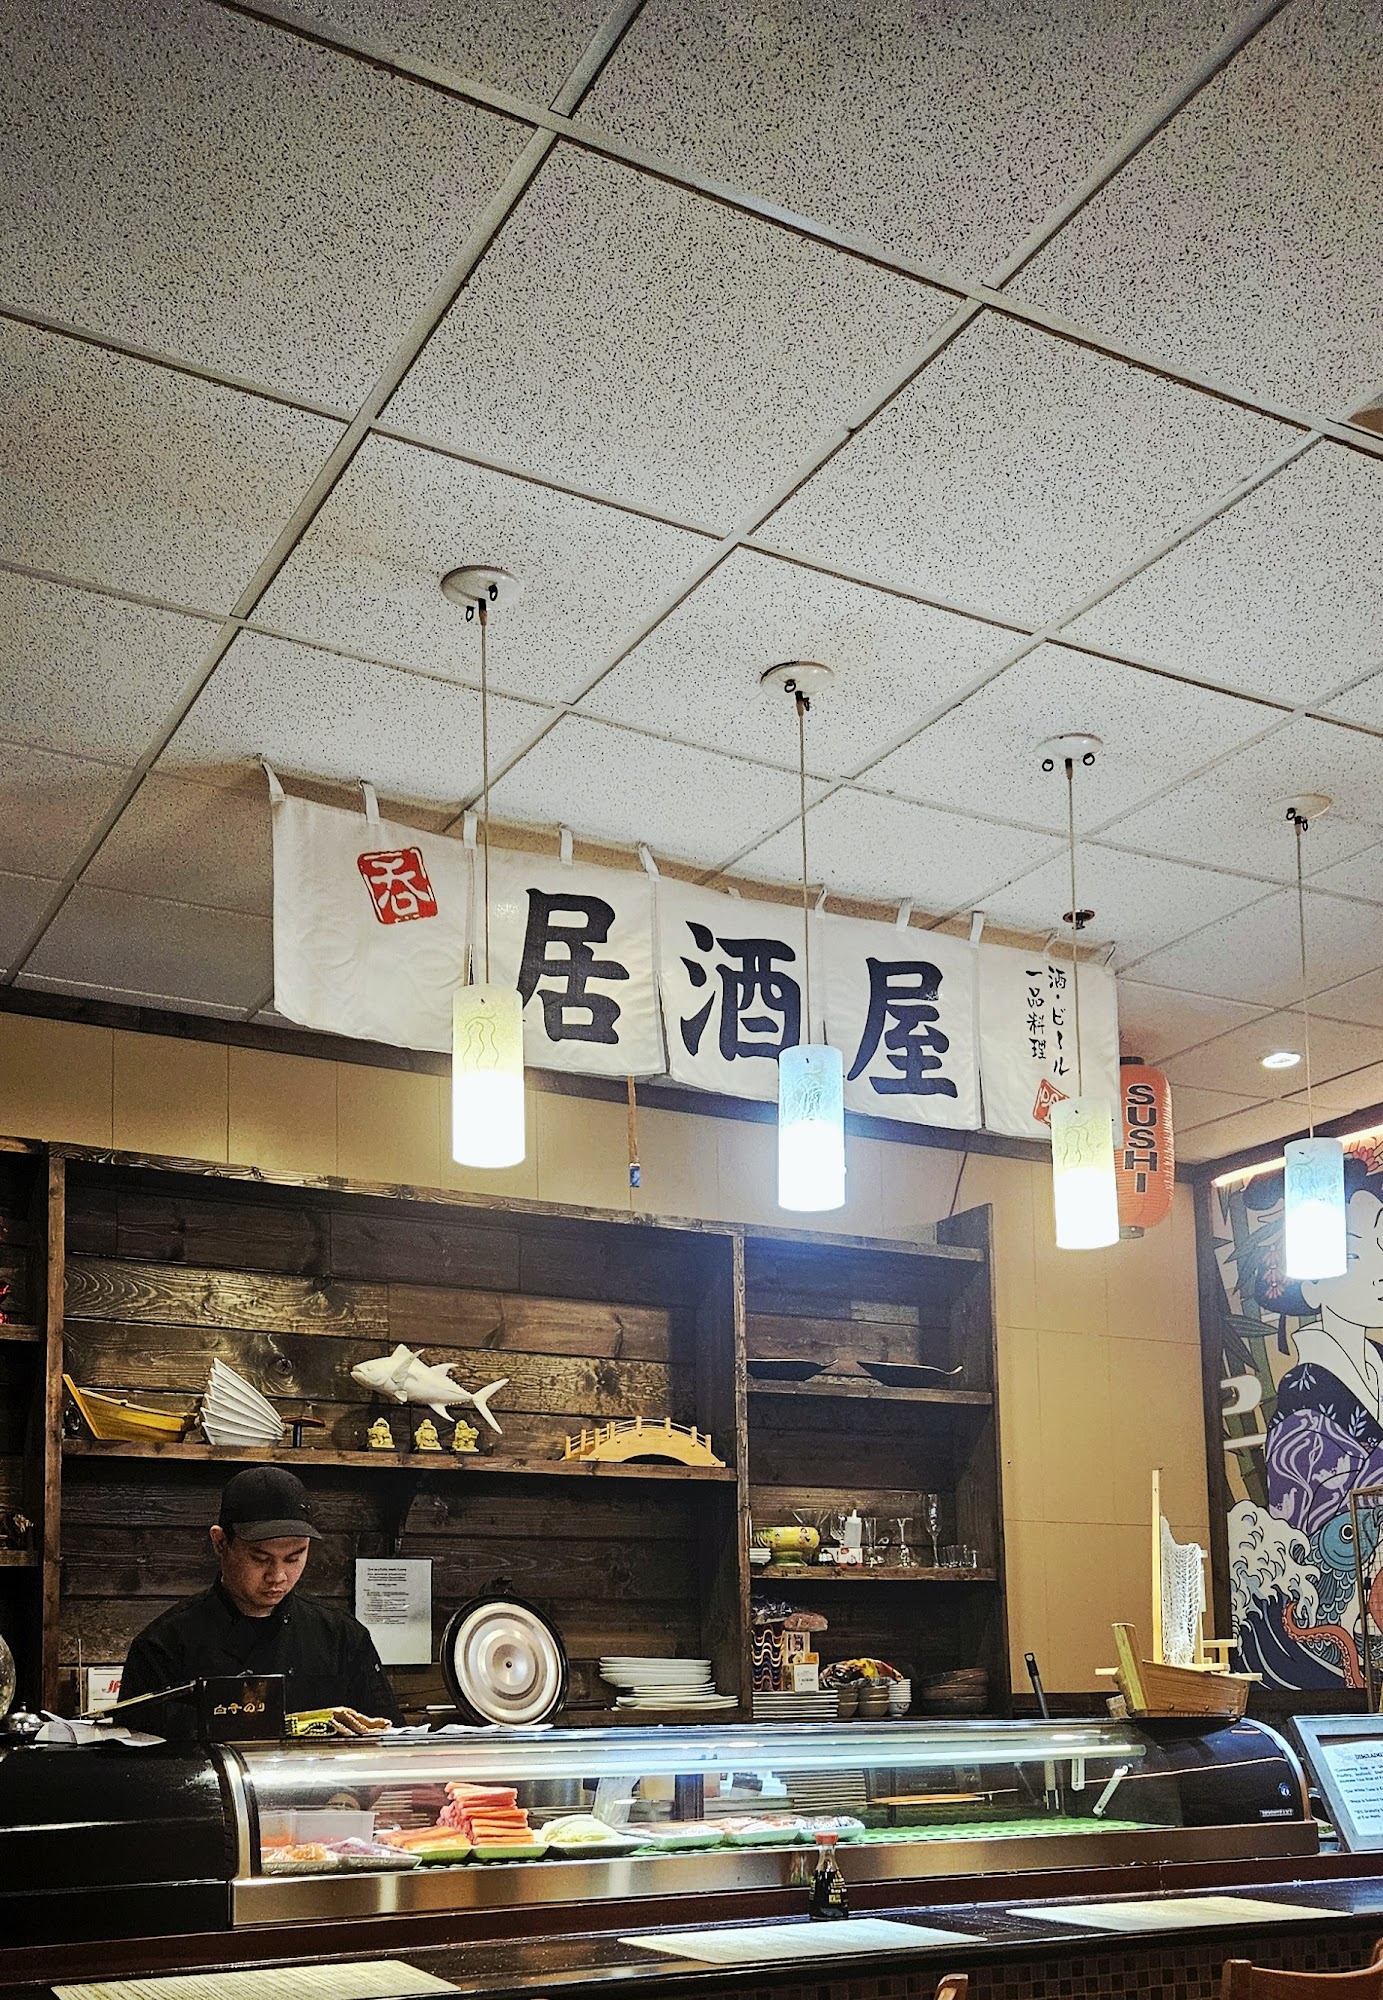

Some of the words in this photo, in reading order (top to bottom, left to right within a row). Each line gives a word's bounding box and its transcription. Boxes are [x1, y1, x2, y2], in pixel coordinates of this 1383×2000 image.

[517, 889, 958, 1099] 居酒屋
[1025, 969, 1047, 1060] 一品料理
[1123, 1083, 1158, 1193] SUSHI
